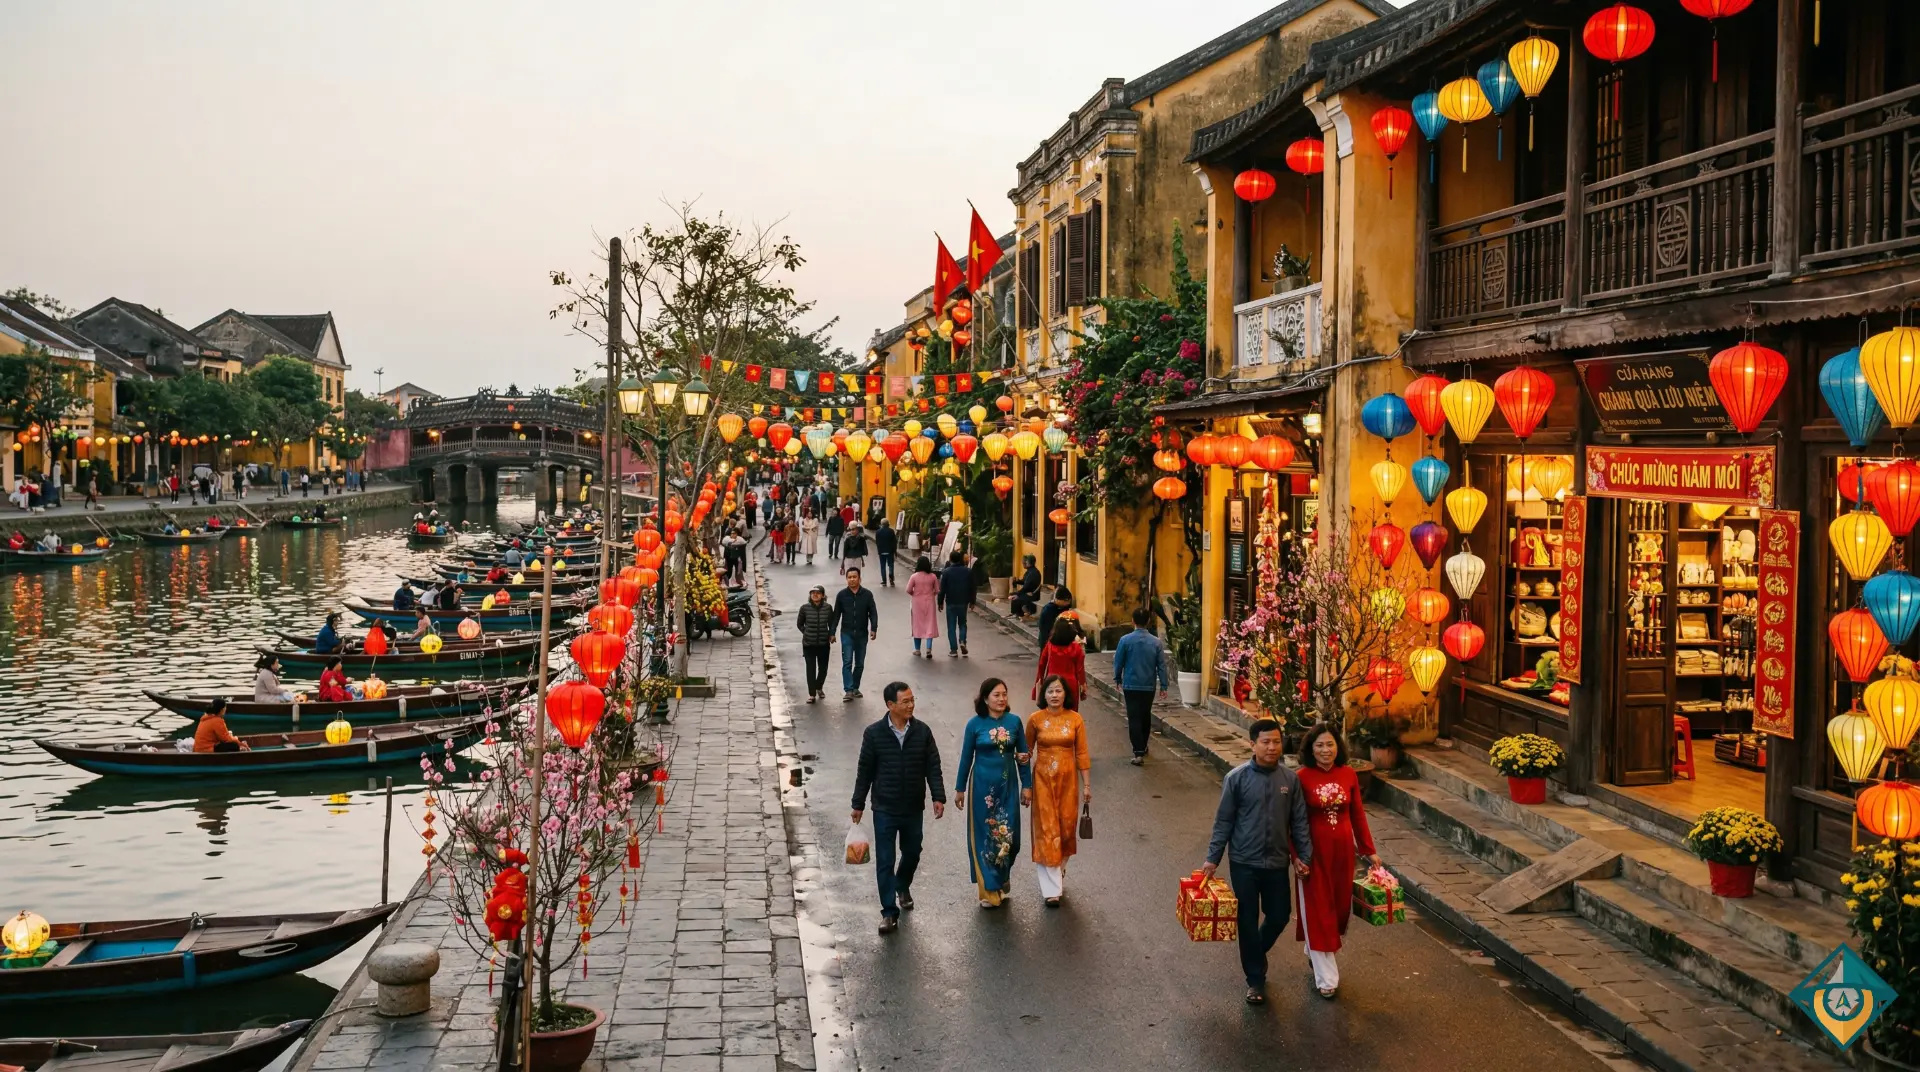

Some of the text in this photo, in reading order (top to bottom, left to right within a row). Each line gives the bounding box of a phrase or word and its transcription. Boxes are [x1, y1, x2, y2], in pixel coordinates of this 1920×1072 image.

[1640, 363, 1674, 380] HÀNG
[1634, 384, 1661, 413] QUÀ
[1683, 381, 1719, 412] NIỆM
[1609, 457, 1741, 489] CHÚC MỪNG NĂM MỚI
